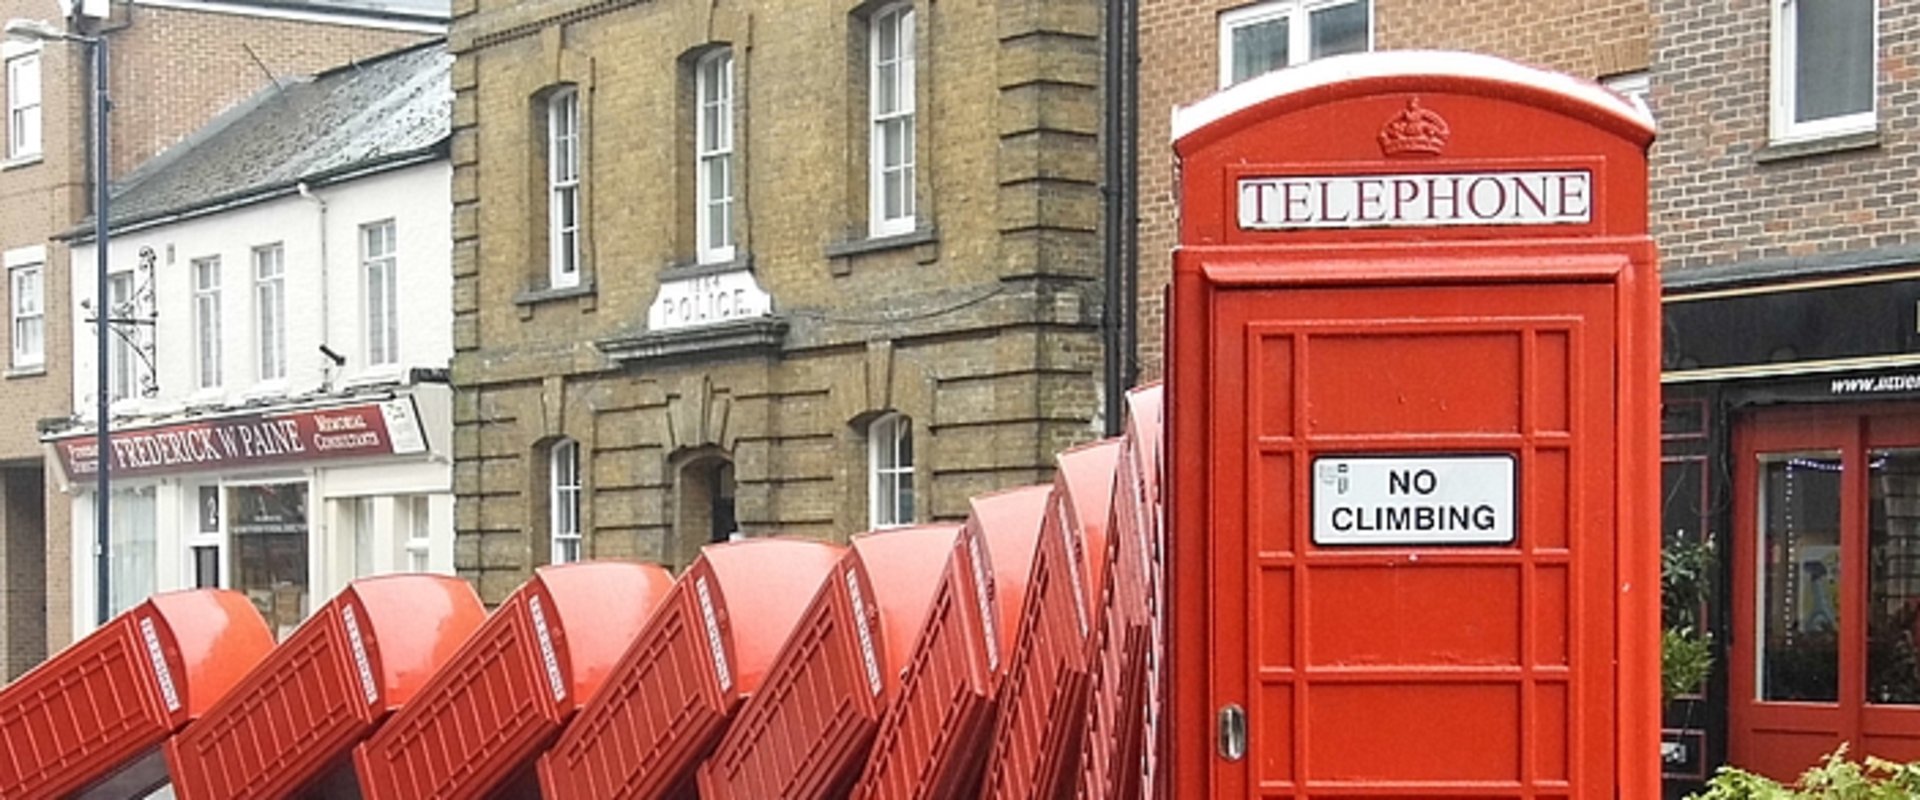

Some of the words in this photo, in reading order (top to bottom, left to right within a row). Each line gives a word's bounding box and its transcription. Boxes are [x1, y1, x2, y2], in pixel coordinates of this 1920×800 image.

[1241, 174, 1588, 224] TELEPHONE
[663, 288, 753, 325] POLICE
[111, 428, 222, 468] FREDERICK
[216, 425, 239, 458] W
[237, 419, 305, 457] PAINE
[1389, 469, 1437, 494] NO
[1331, 505, 1496, 531] CLIMBING
